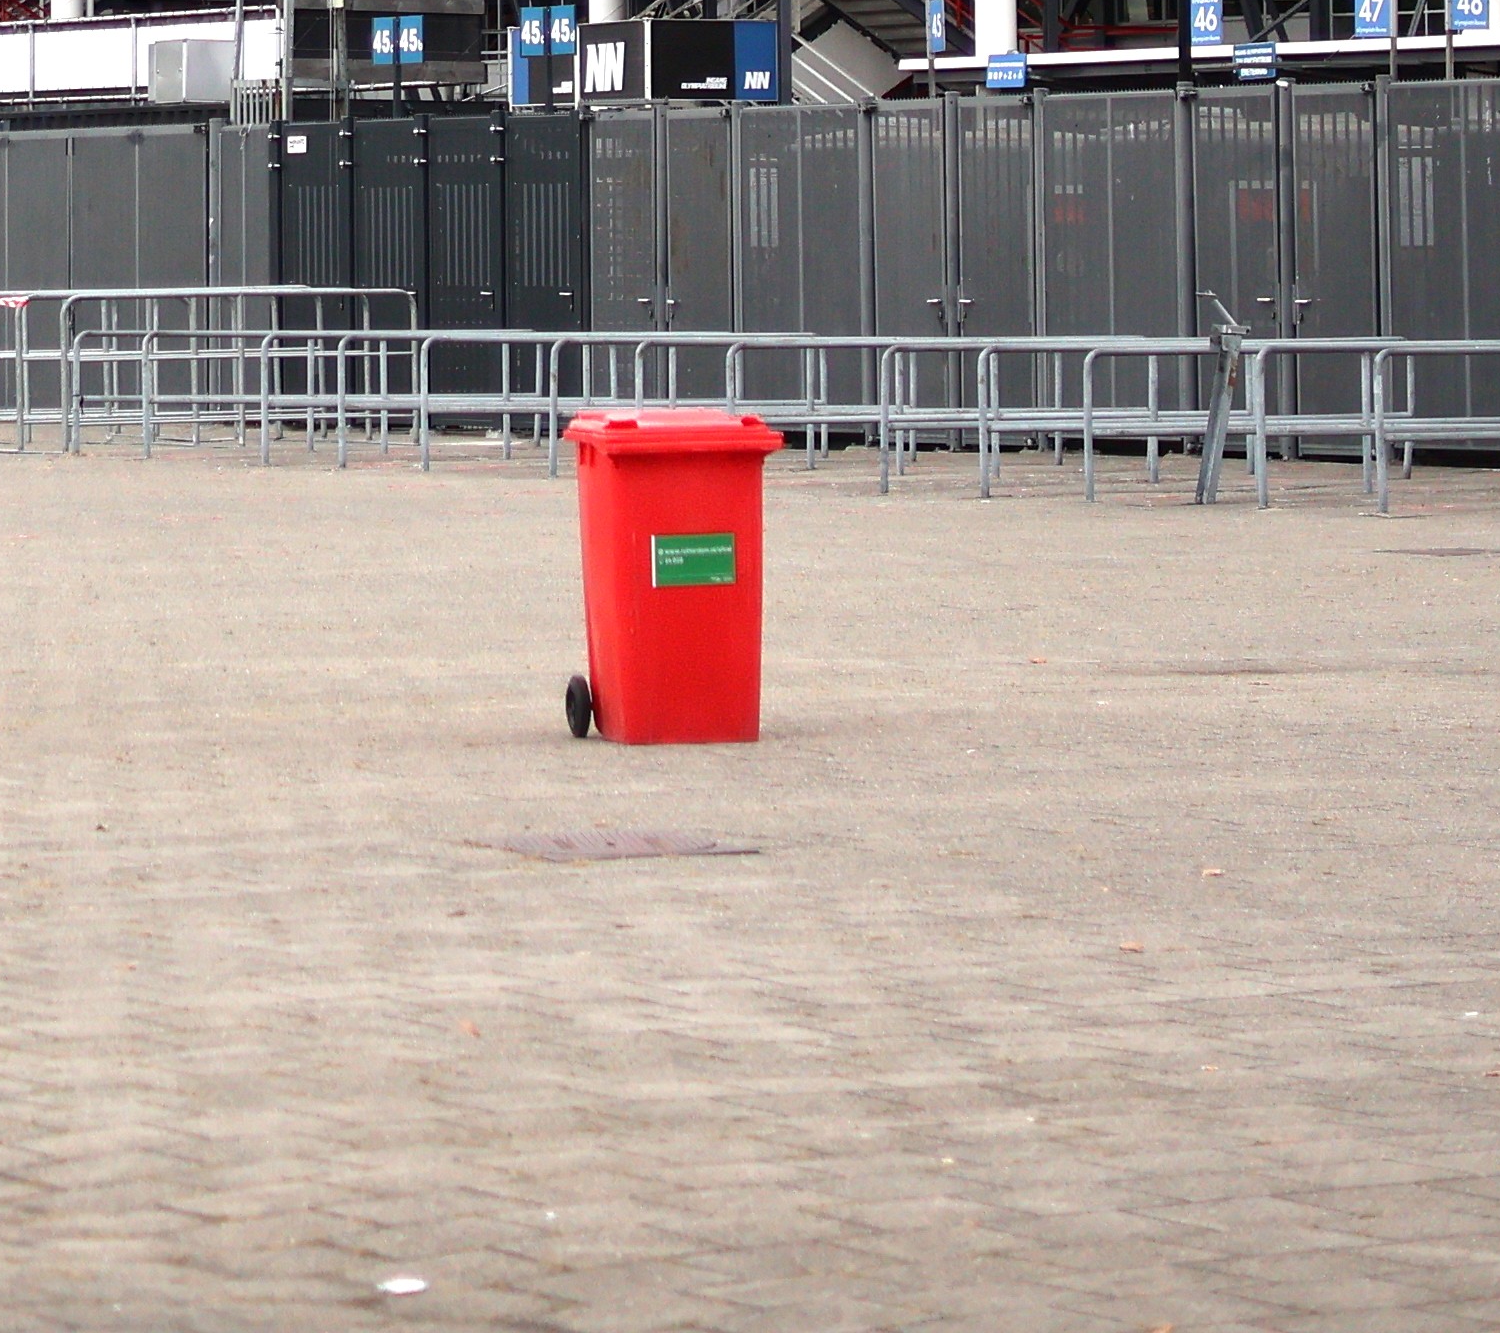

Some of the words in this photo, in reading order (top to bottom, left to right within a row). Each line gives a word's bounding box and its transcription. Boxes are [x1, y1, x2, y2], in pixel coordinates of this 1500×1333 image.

[932, 13, 942, 38] 45
[1194, 6, 1217, 31] 46
[584, 42, 625, 93] NN
[744, 72, 770, 89] NN
